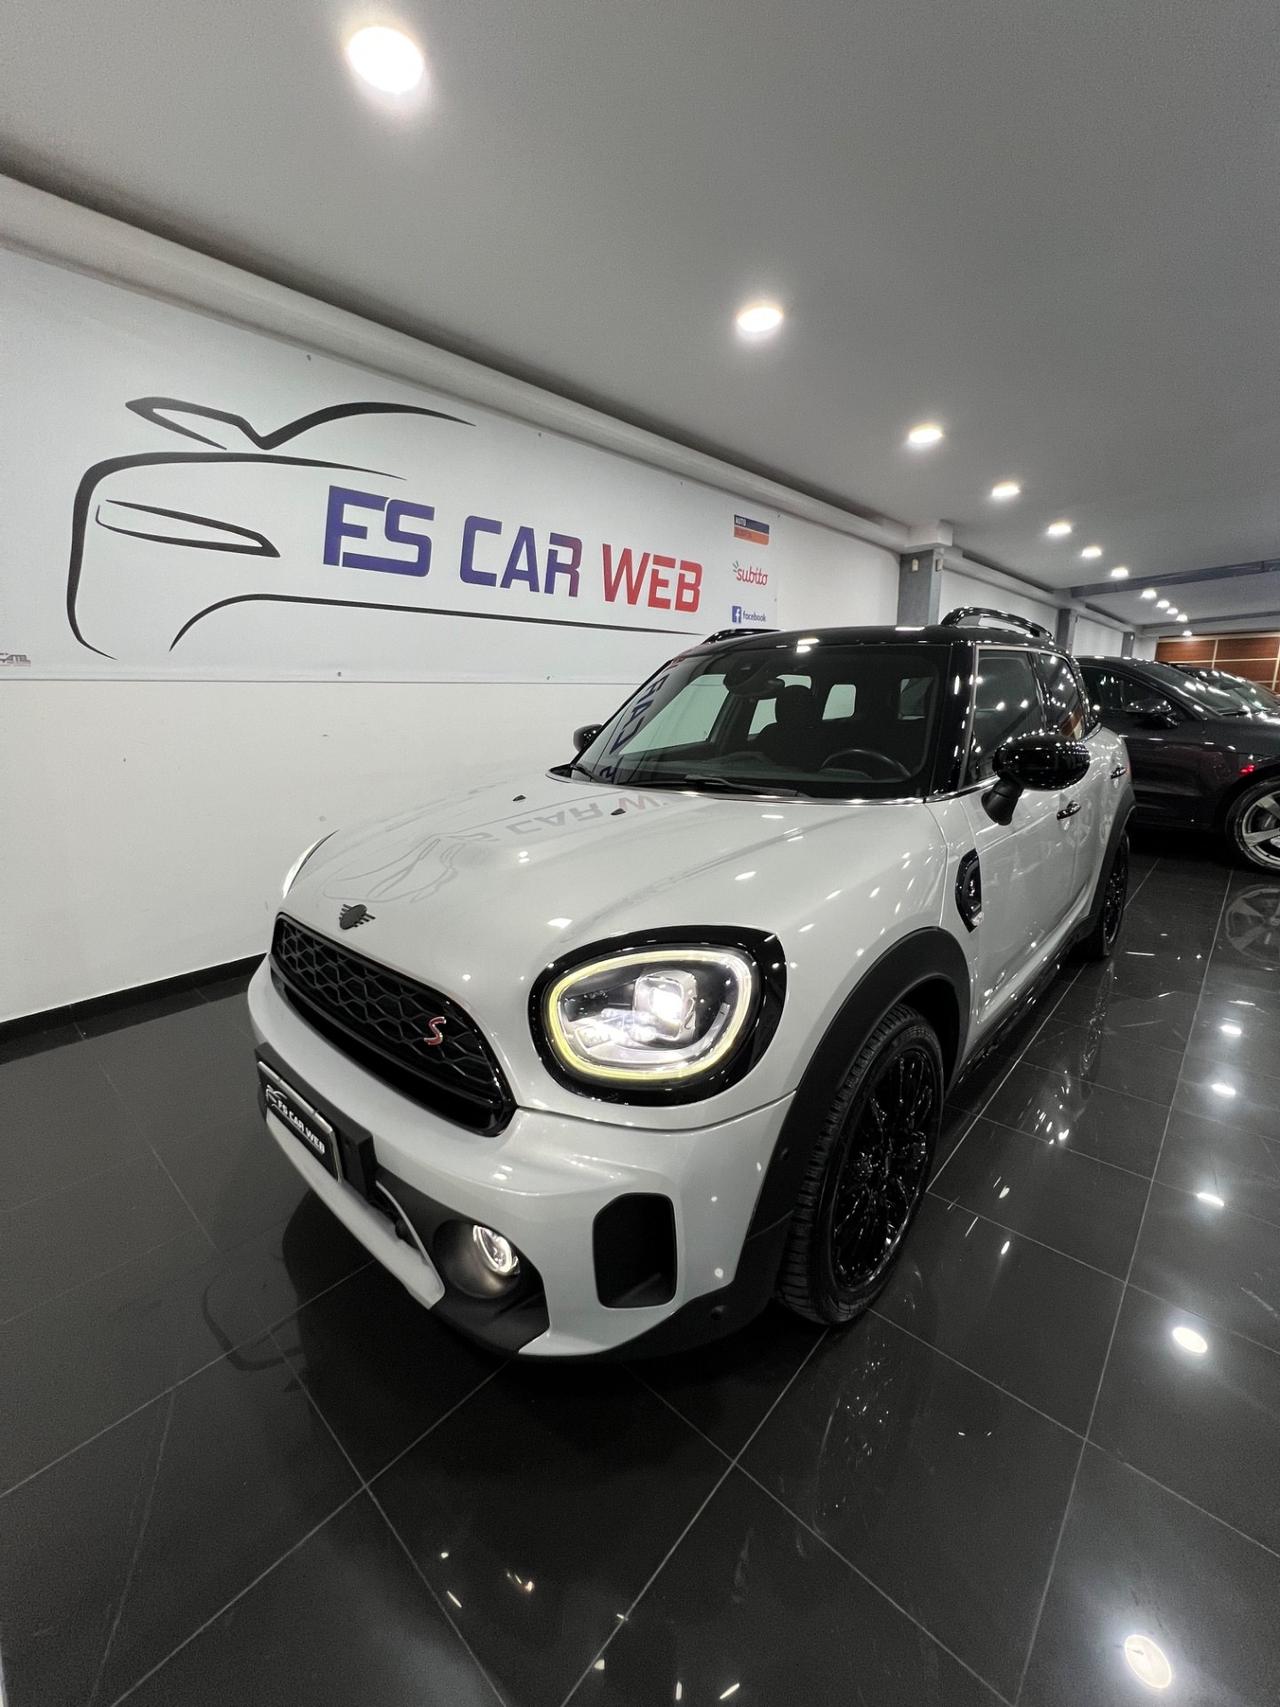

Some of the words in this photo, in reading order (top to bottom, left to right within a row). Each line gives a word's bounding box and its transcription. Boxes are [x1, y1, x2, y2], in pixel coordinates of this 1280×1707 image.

[323, 485, 435, 577] ES
[460, 515, 582, 597] CAR
[602, 543, 703, 612] WEB
[736, 566, 768, 585] subito
[743, 611, 766, 622] facebook
[423, 1016, 447, 1045] S
